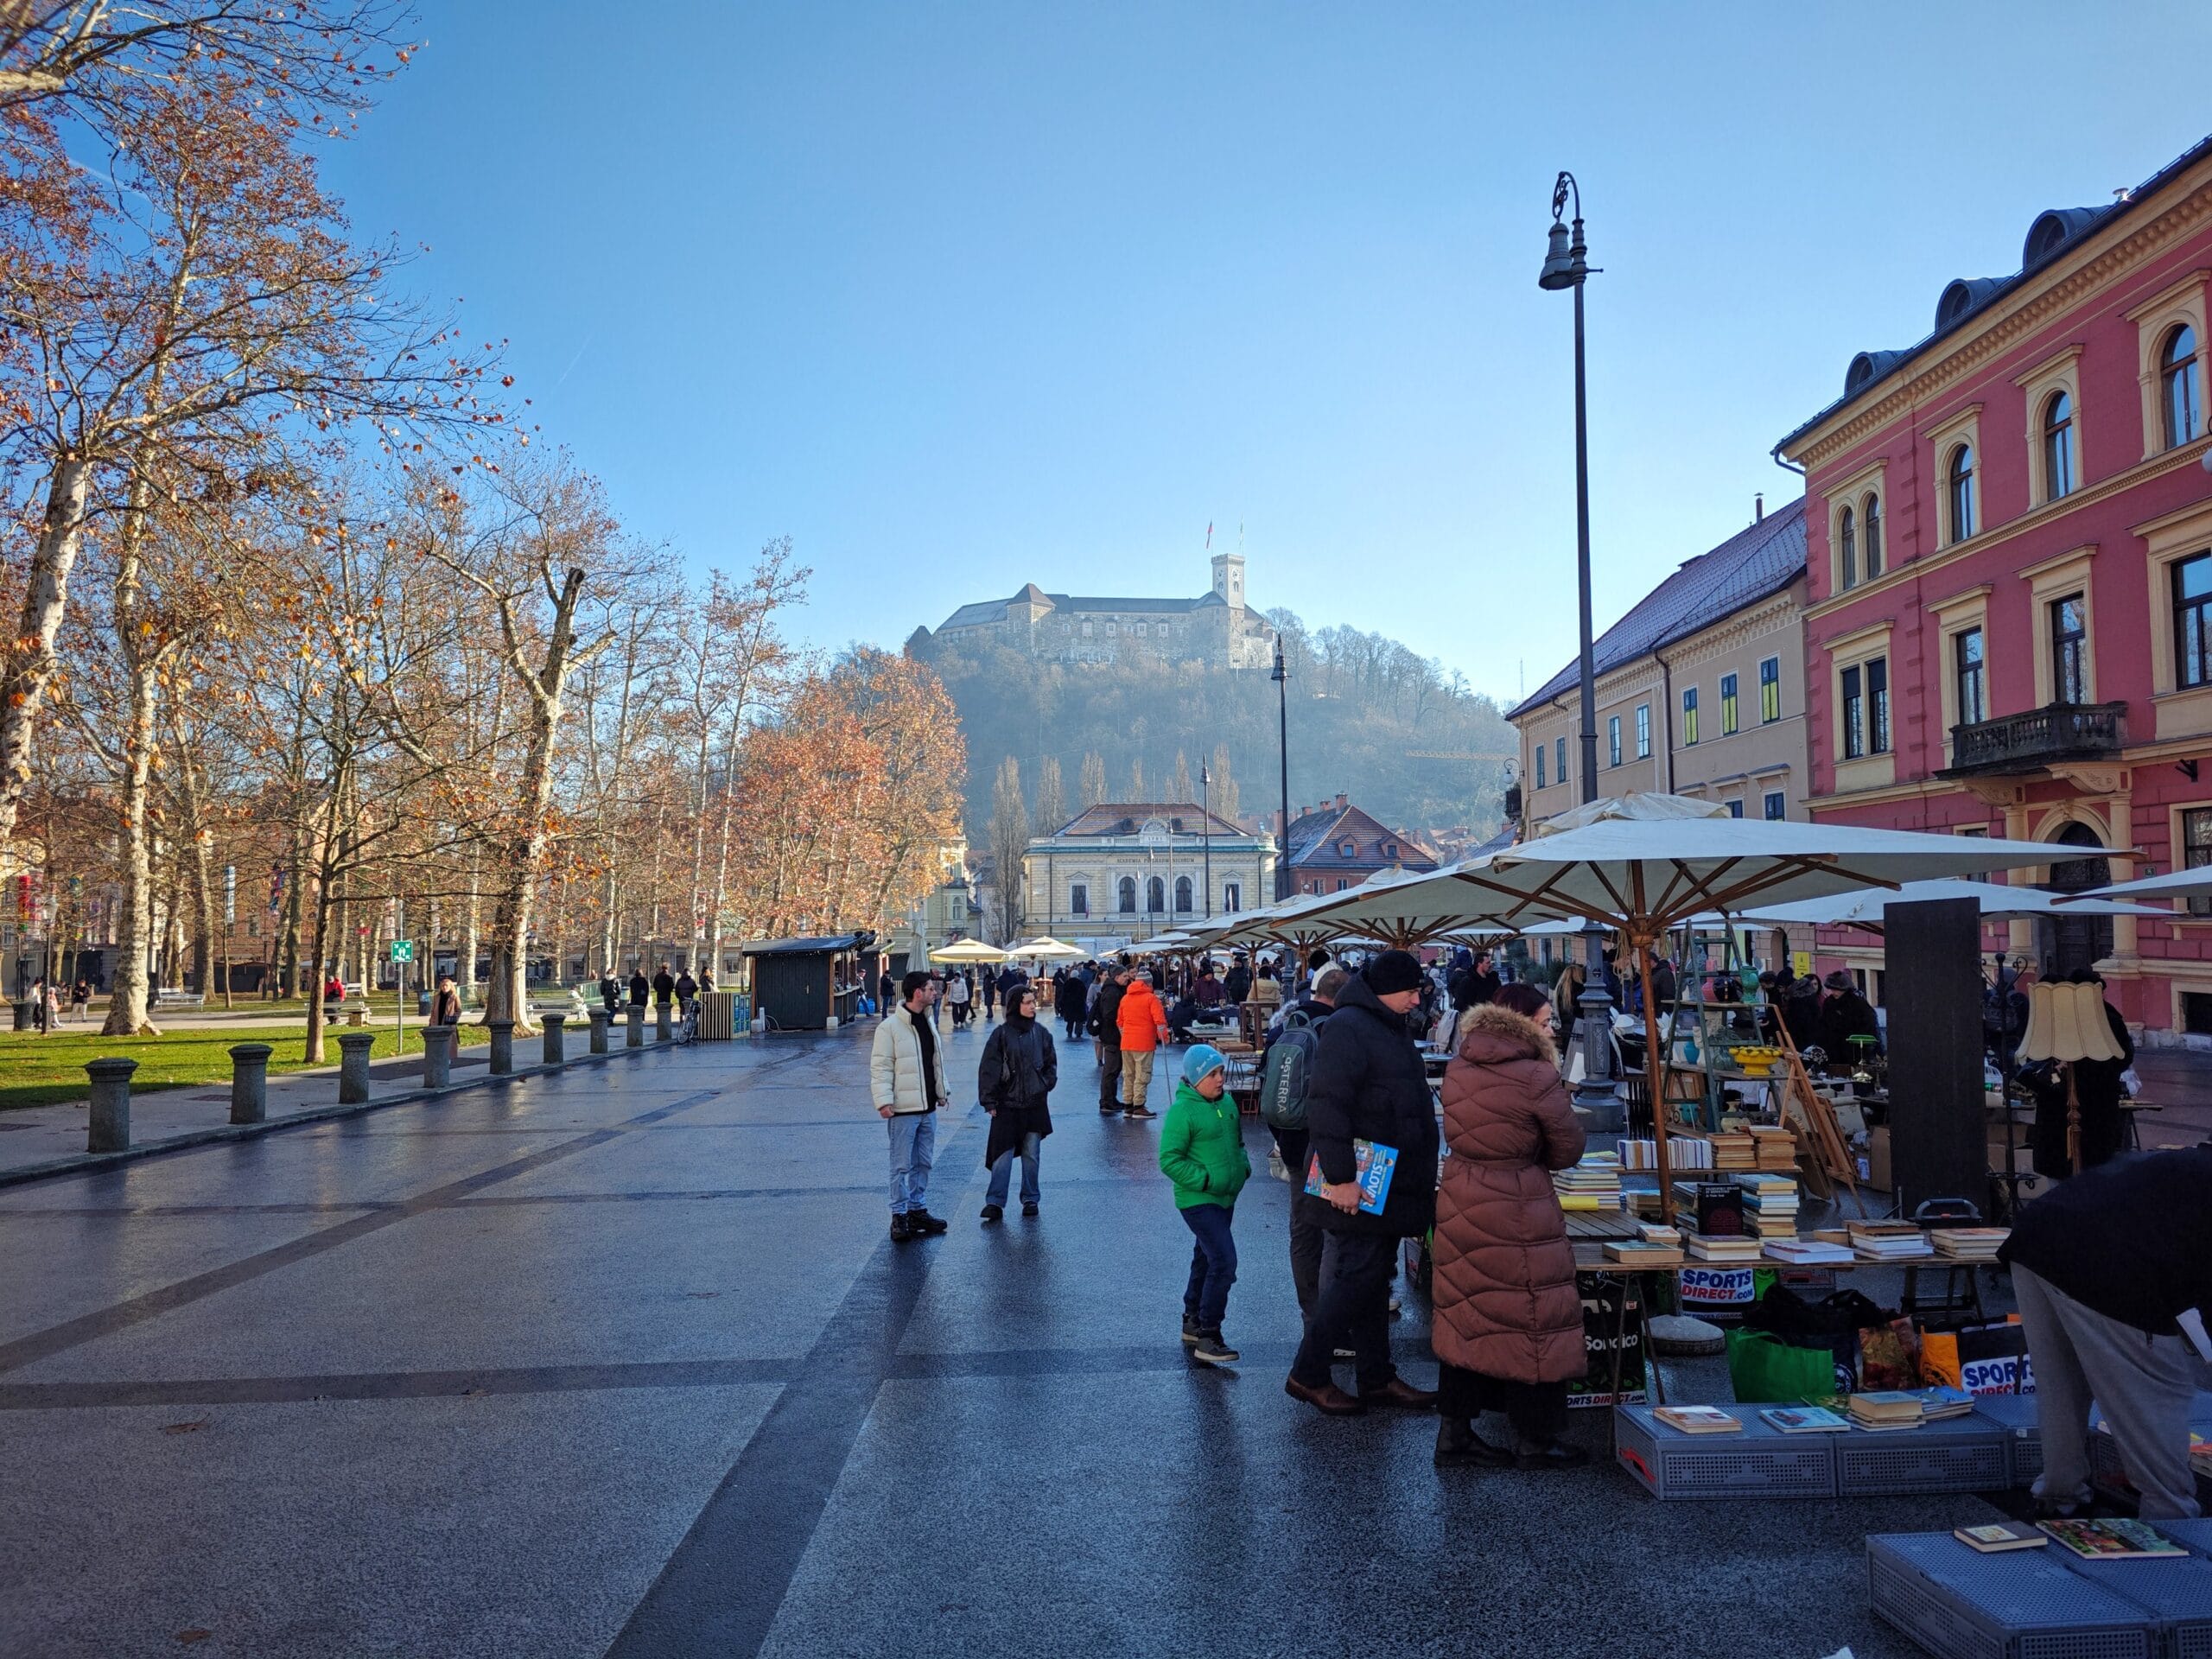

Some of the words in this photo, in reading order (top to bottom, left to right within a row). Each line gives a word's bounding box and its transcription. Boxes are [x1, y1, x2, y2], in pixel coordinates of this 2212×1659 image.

[1682, 1269, 1751, 1288] SPORTS
[1681, 1284, 1753, 1300] DIRECT.COM
[1964, 1360, 2034, 1387] SPORT
